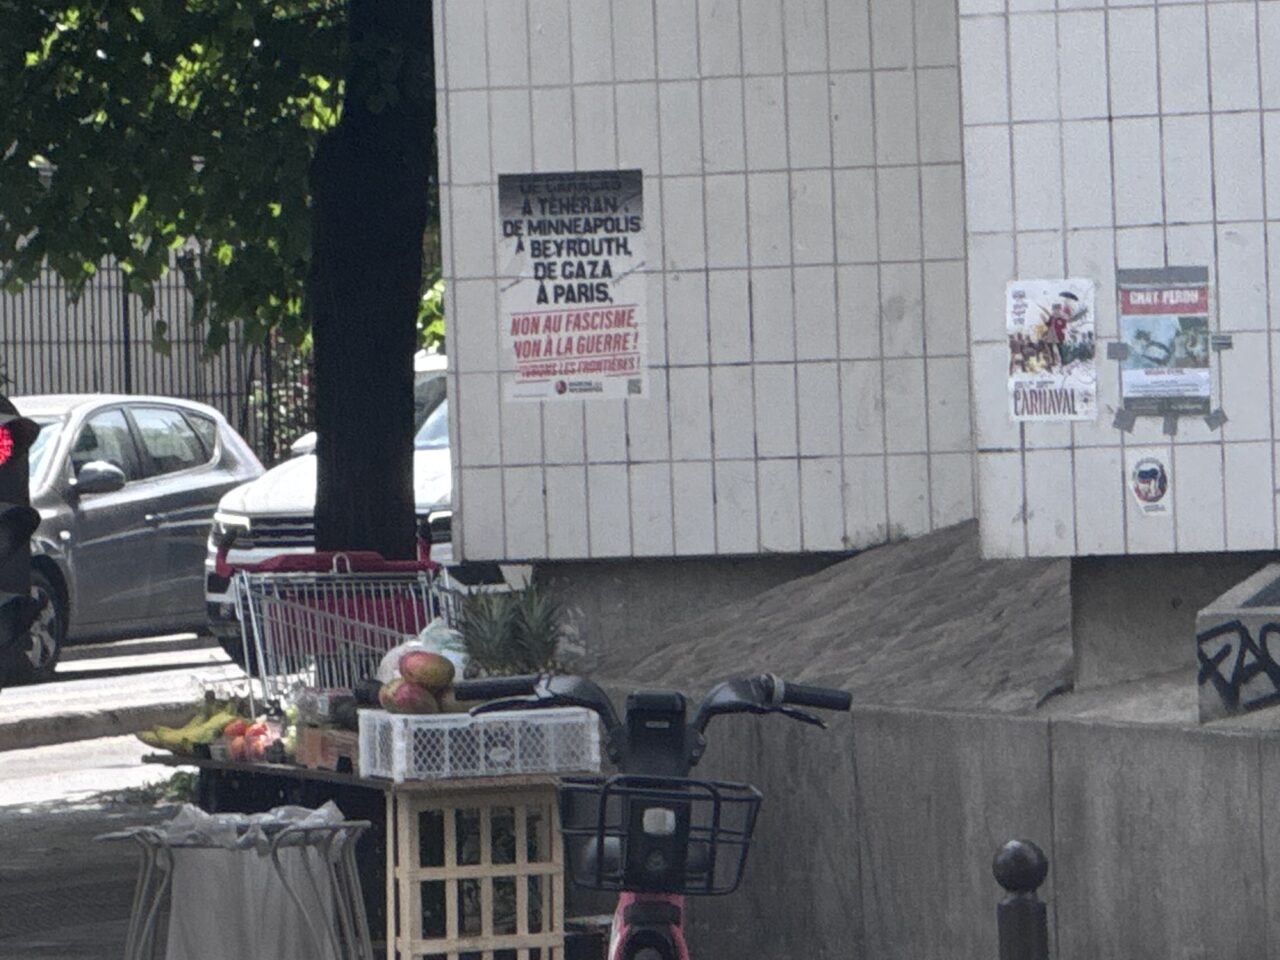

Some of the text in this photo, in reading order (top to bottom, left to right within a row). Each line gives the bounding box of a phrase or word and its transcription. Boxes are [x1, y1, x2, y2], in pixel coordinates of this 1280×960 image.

[502, 216, 642, 237] DE MINNEAPOLIS
[534, 259, 612, 280] DE GAZA
[536, 279, 614, 305] À PARIS,
[510, 309, 639, 336] NON AU FASCISME,
[556, 336, 573, 356] LA
[1013, 388, 1078, 417] CARNAVAL
